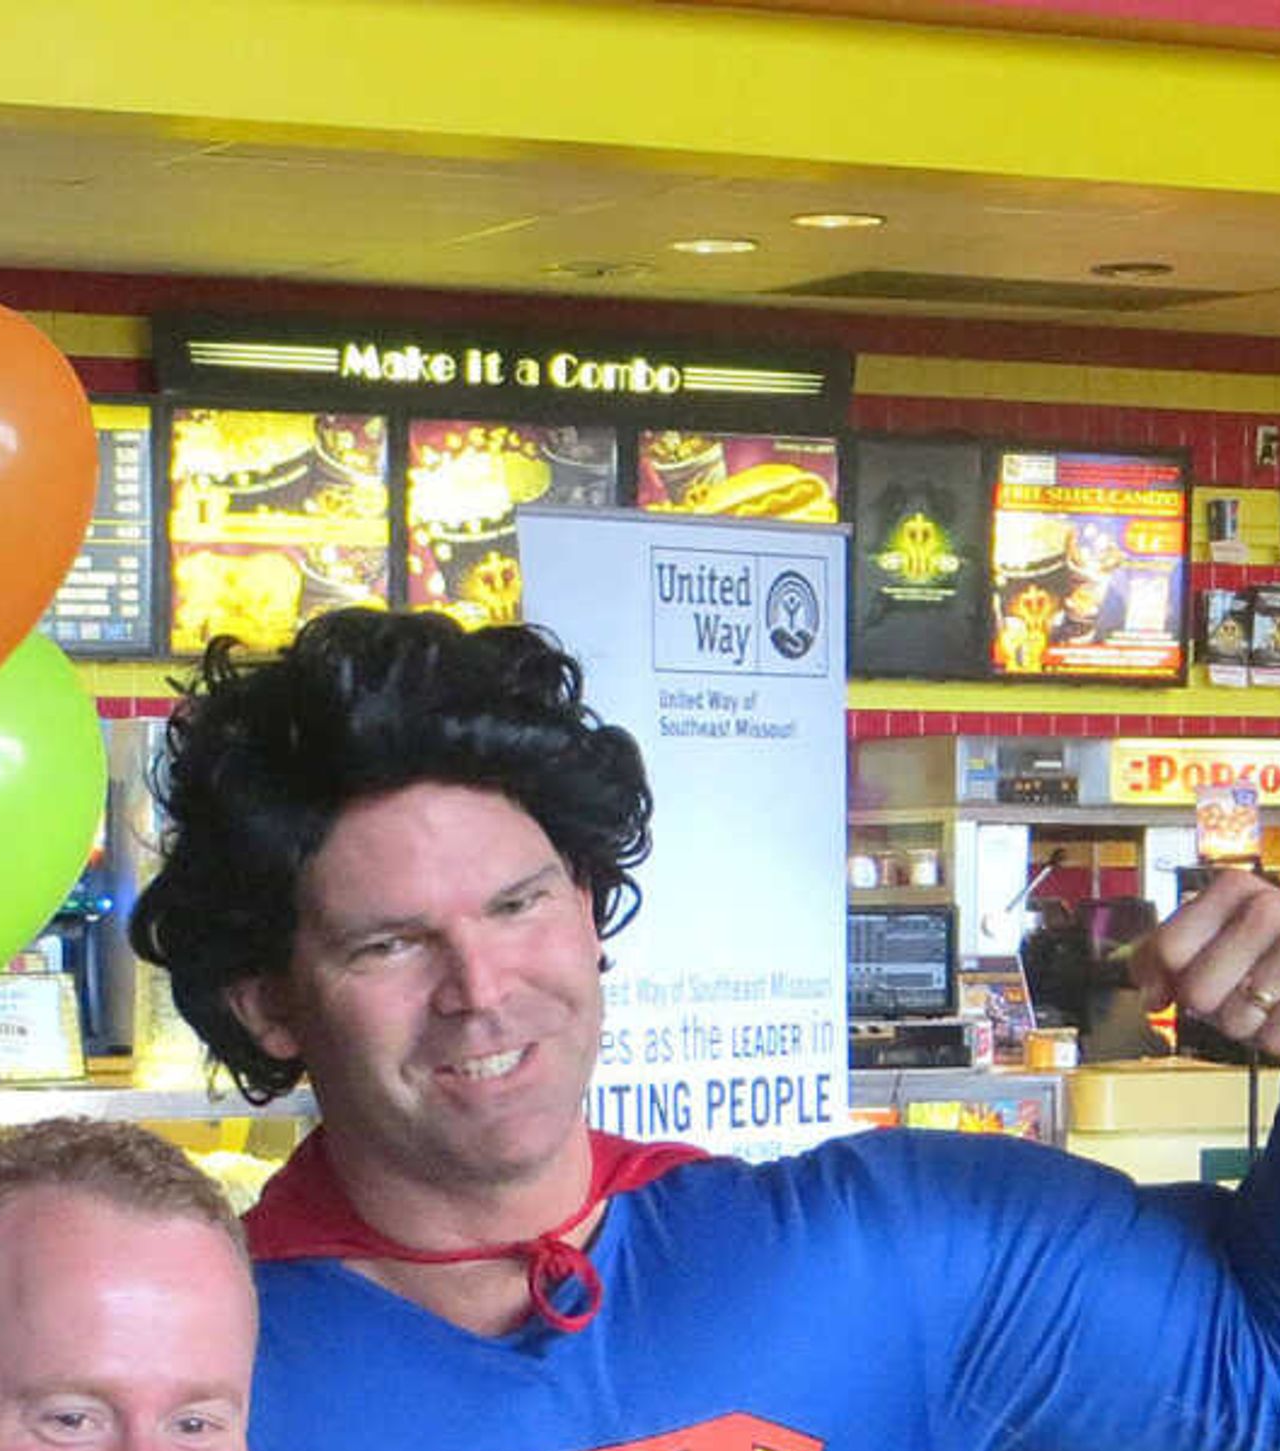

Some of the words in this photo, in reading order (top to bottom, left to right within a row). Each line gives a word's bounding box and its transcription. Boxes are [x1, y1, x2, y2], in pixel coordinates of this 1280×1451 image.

[340, 344, 456, 384] Make
[515, 359, 540, 386] a
[549, 353, 682, 393] Combo
[656, 563, 752, 606] United
[693, 612, 751, 665] Way
[600, 1028, 633, 1064] es
[644, 1027, 675, 1063] as
[680, 1012, 722, 1060] the
[731, 1024, 802, 1058] LEADER
[585, 1080, 691, 1138] ITING
[706, 1073, 832, 1131] PEOPLE
